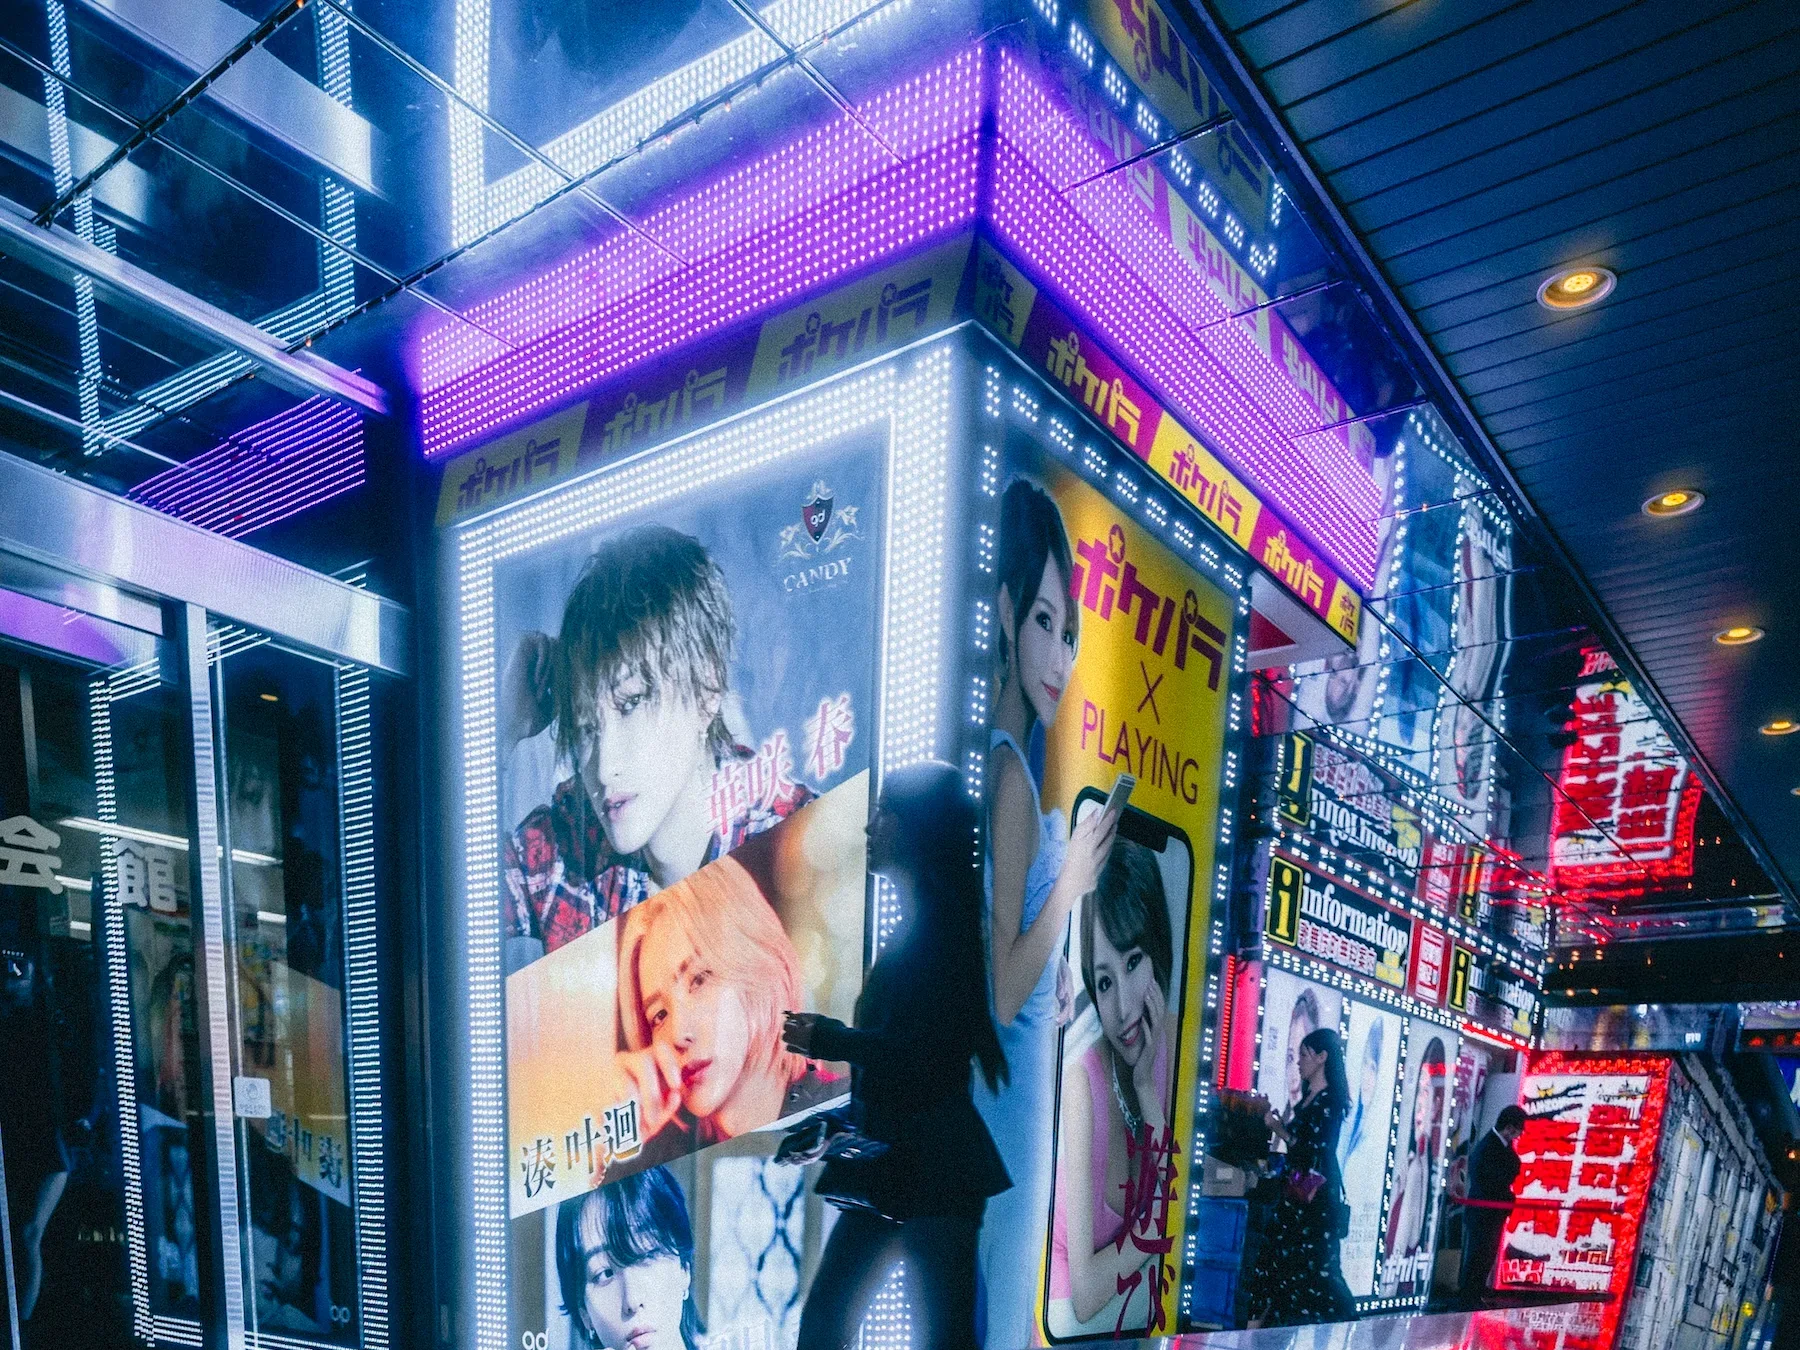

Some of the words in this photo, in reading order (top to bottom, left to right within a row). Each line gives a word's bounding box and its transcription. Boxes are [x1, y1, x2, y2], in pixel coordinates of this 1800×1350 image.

[779, 280, 934, 382] ポケパラ
[604, 368, 728, 452] ポケパラ
[1046, 331, 1141, 446] ポケパラ
[458, 439, 560, 507] ポケパラ
[1169, 444, 1243, 537] ポケパラ
[783, 557, 852, 593] CANDY
[1069, 523, 1227, 692] ポケパラ
[1263, 530, 1325, 609] ポケパラ
[1080, 698, 1199, 806] PLAYING
[1300, 872, 1408, 957] information
